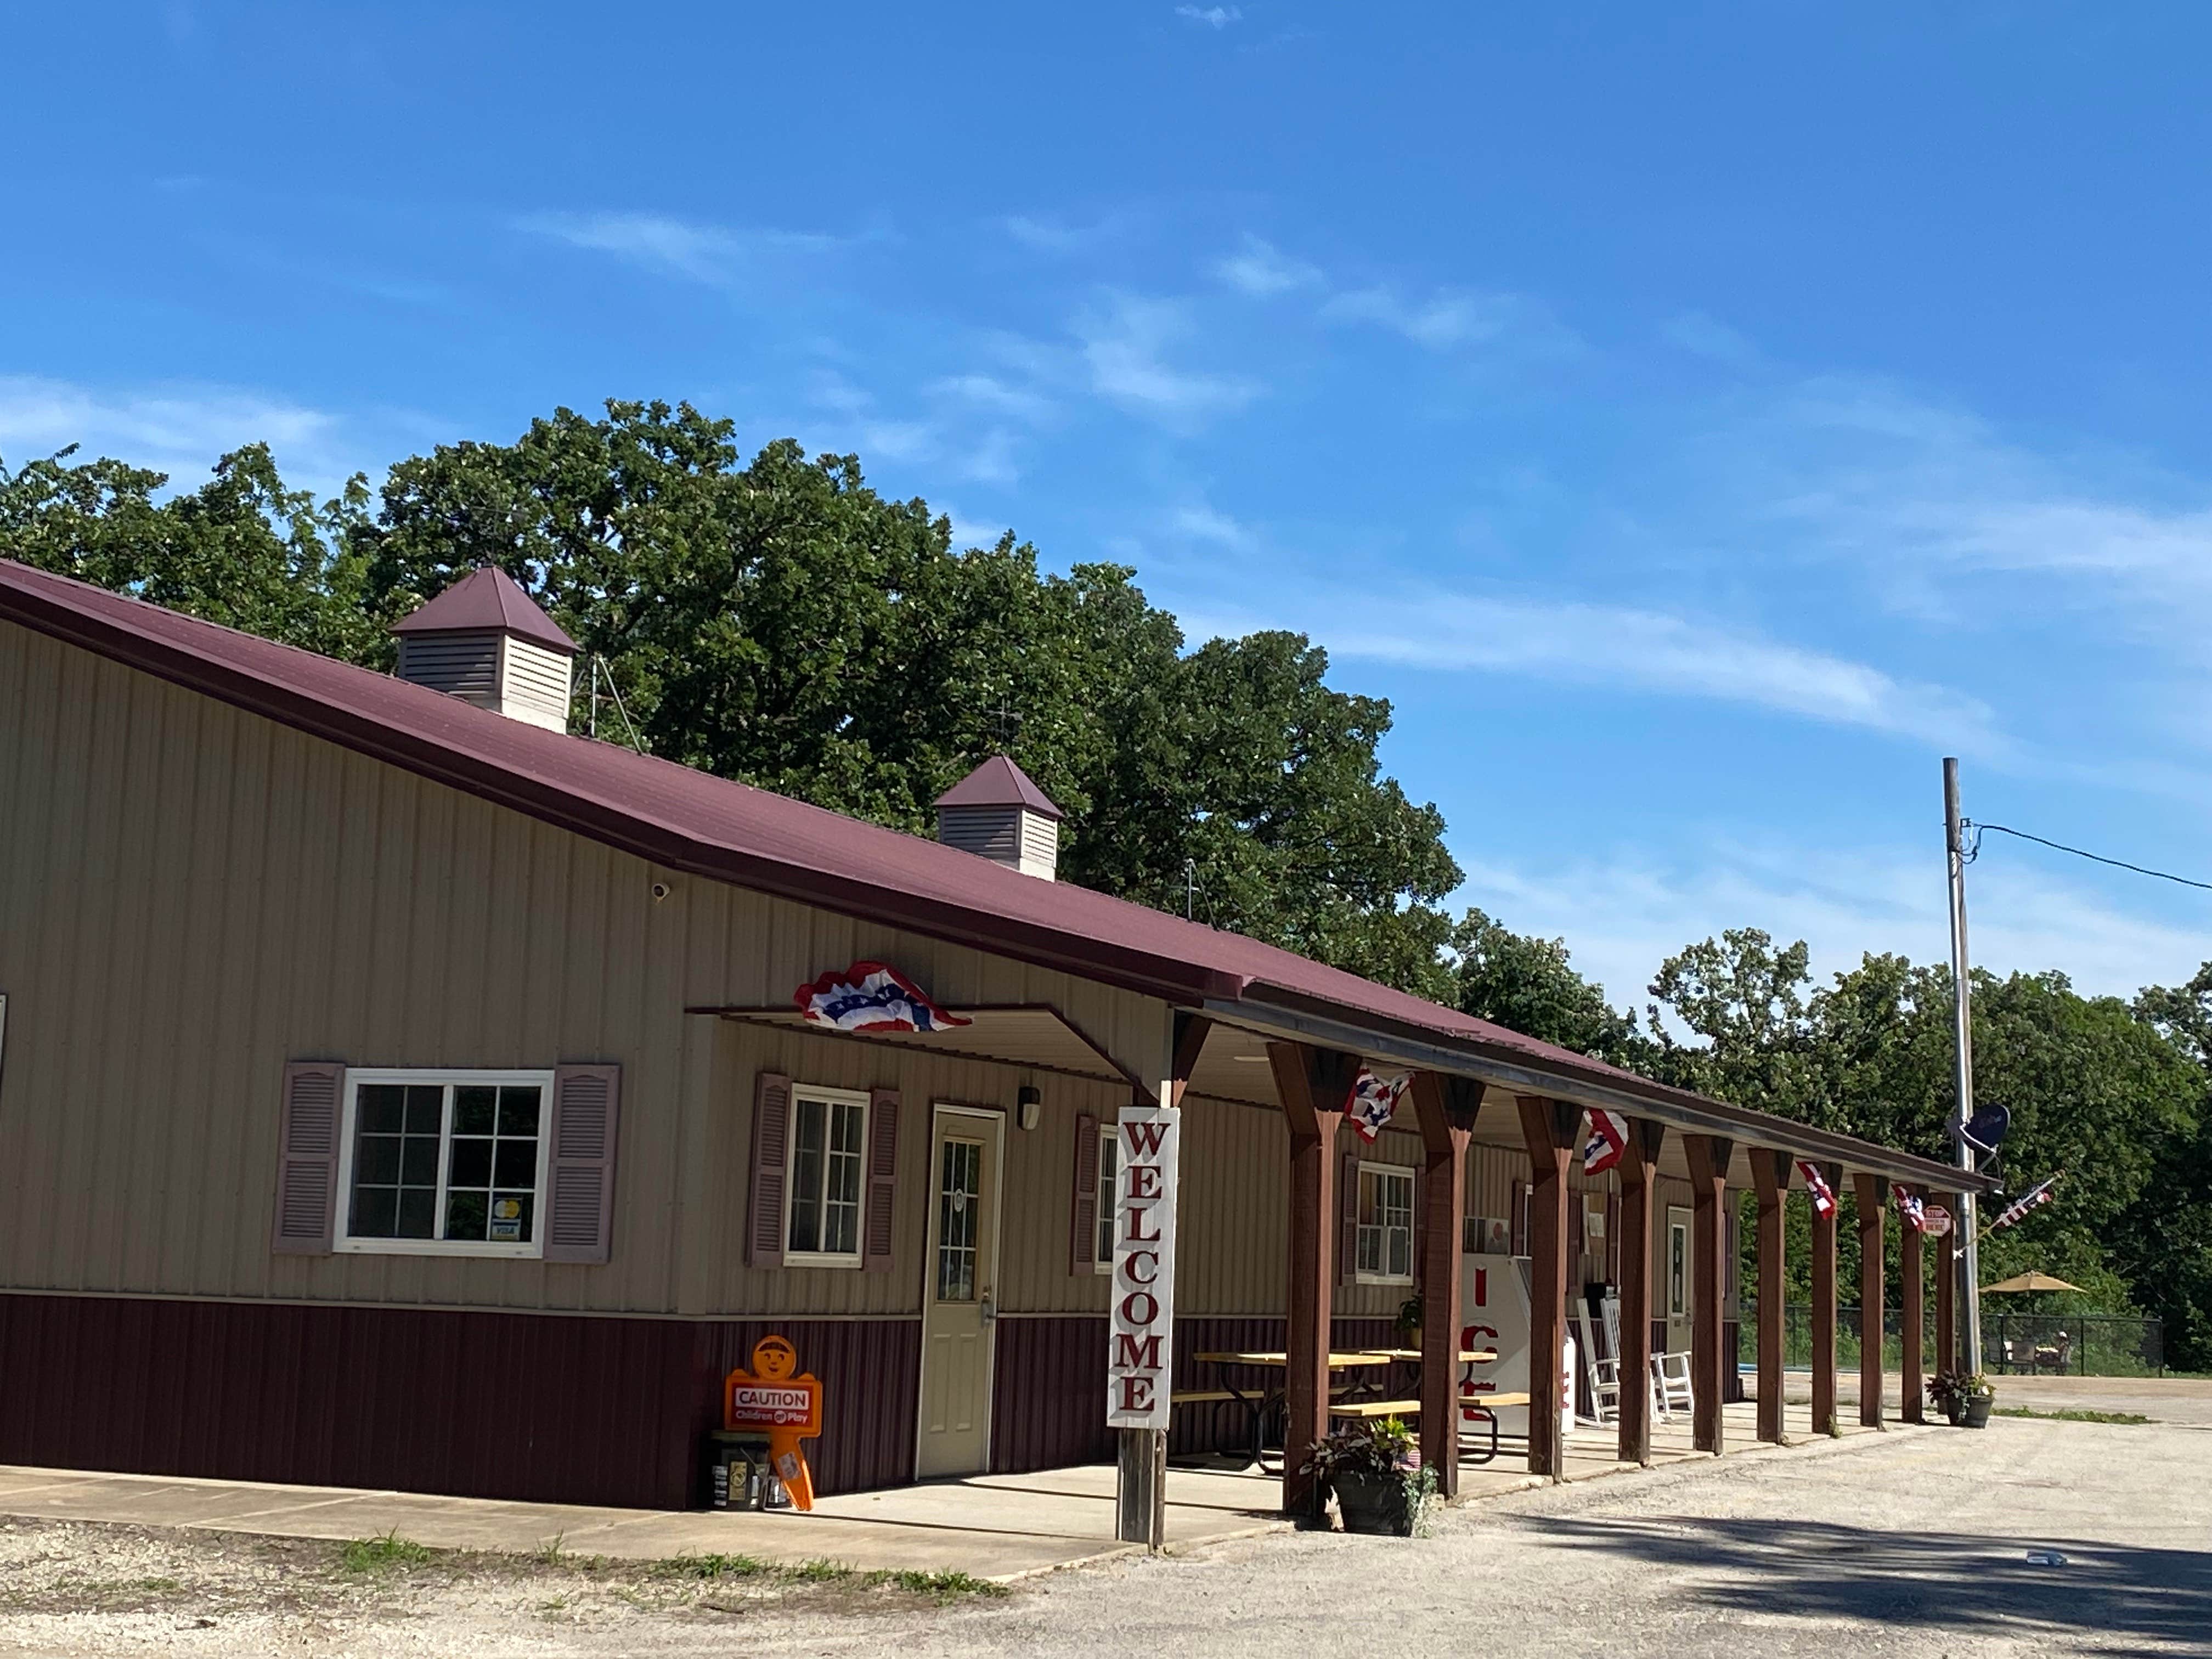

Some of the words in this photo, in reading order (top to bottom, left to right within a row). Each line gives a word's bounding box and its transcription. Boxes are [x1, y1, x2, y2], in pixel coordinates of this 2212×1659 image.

[1115, 1121, 1171, 1412] WELCOME
[1460, 1267, 1499, 1421] ICE
[739, 1391, 806, 1407] CAUTION
[787, 1412, 808, 1424] Play
